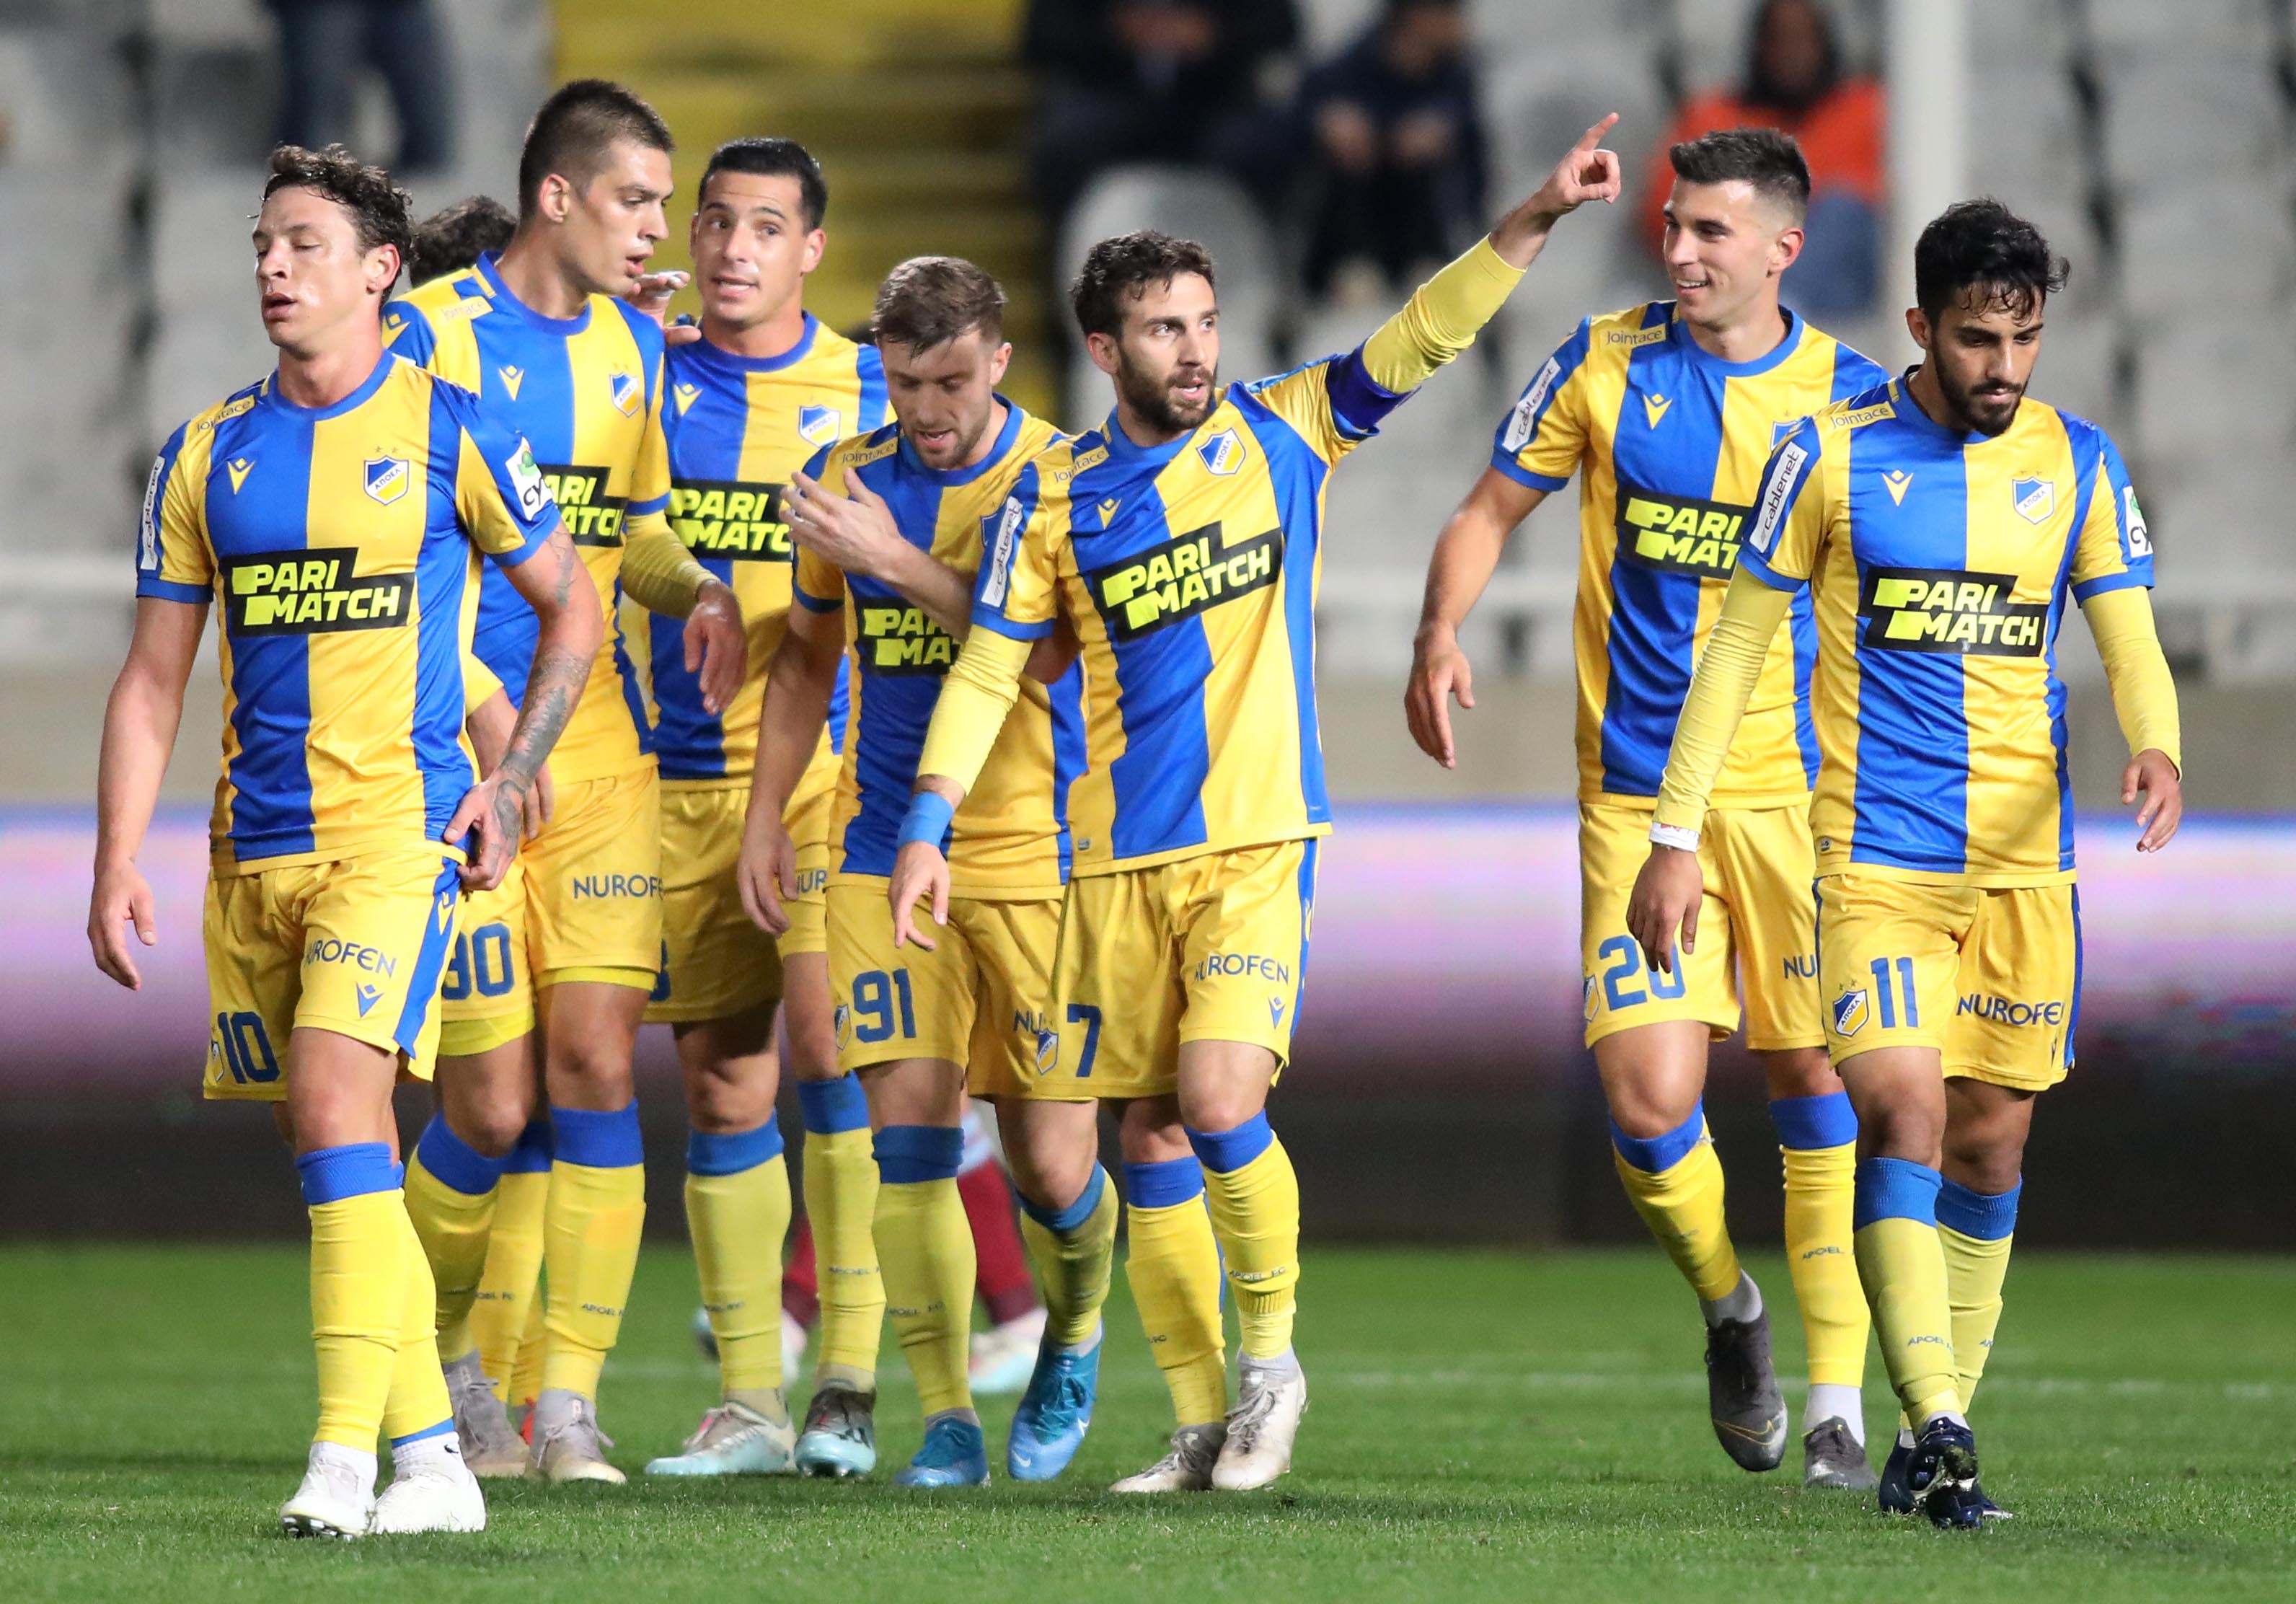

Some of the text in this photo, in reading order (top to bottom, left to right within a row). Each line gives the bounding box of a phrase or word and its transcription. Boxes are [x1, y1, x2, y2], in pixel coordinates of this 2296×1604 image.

[1606, 330, 1662, 345] Jointace
[1830, 407, 1889, 429] Jointace
[544, 475, 597, 505] ARI
[665, 488, 769, 521] PARI
[1765, 451, 1800, 530] cablenet
[560, 506, 624, 537] ATCH
[671, 518, 791, 553] MATC
[1625, 497, 1742, 542] PARI
[1635, 529, 1741, 570] MAT
[231, 560, 340, 595] PARI
[1102, 537, 1211, 609] PARI
[1125, 544, 1271, 630] MATCH
[244, 586, 399, 626] MATCH
[1873, 578, 1998, 613] PARI
[1884, 611, 2040, 646] MATCH
[852, 968, 917, 1043] 91
[1871, 956, 1919, 1028] 11
[1956, 994, 2065, 1026] NUROFE
[217, 1012, 280, 1083] 10
[1067, 1003, 1101, 1077] 7
[1908, 1336, 1944, 1347] APOEL
